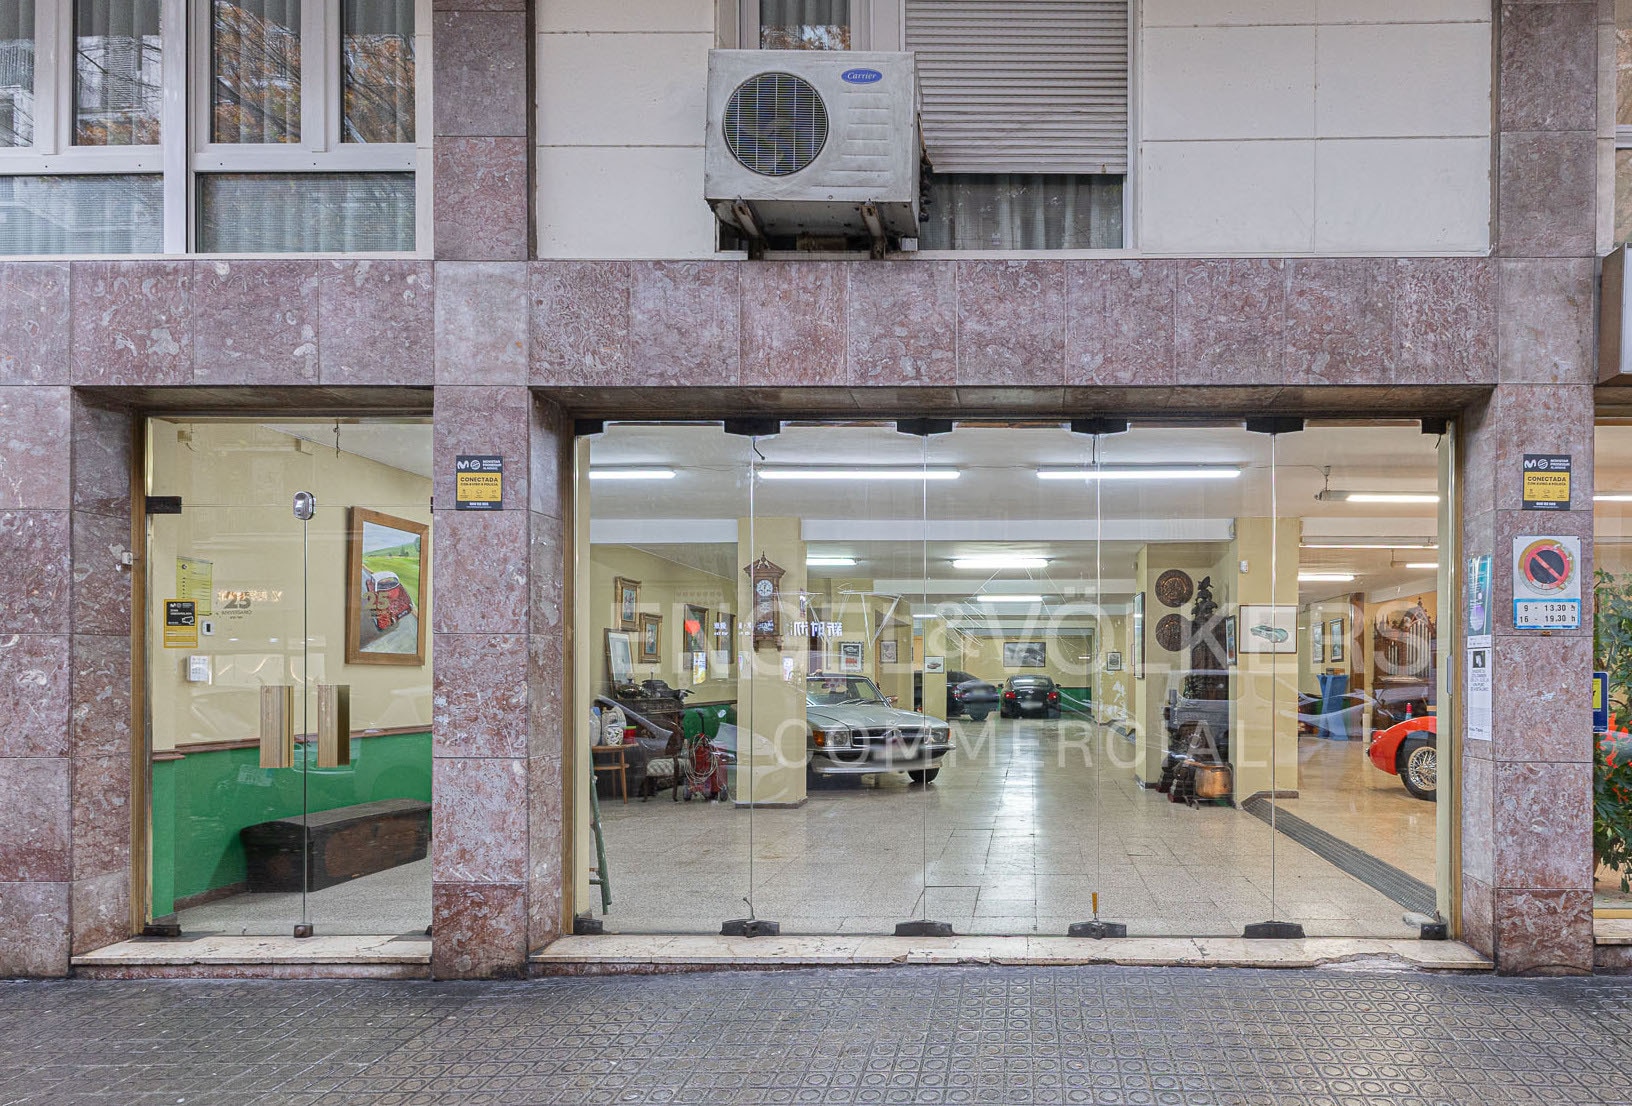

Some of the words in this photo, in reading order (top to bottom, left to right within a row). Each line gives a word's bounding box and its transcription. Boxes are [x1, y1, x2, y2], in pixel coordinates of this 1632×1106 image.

[223, 592, 251, 609] 25
[363, 592, 389, 609] 25
[1523, 604, 1529, 612] 9
[1544, 604, 1567, 612] 13.30
